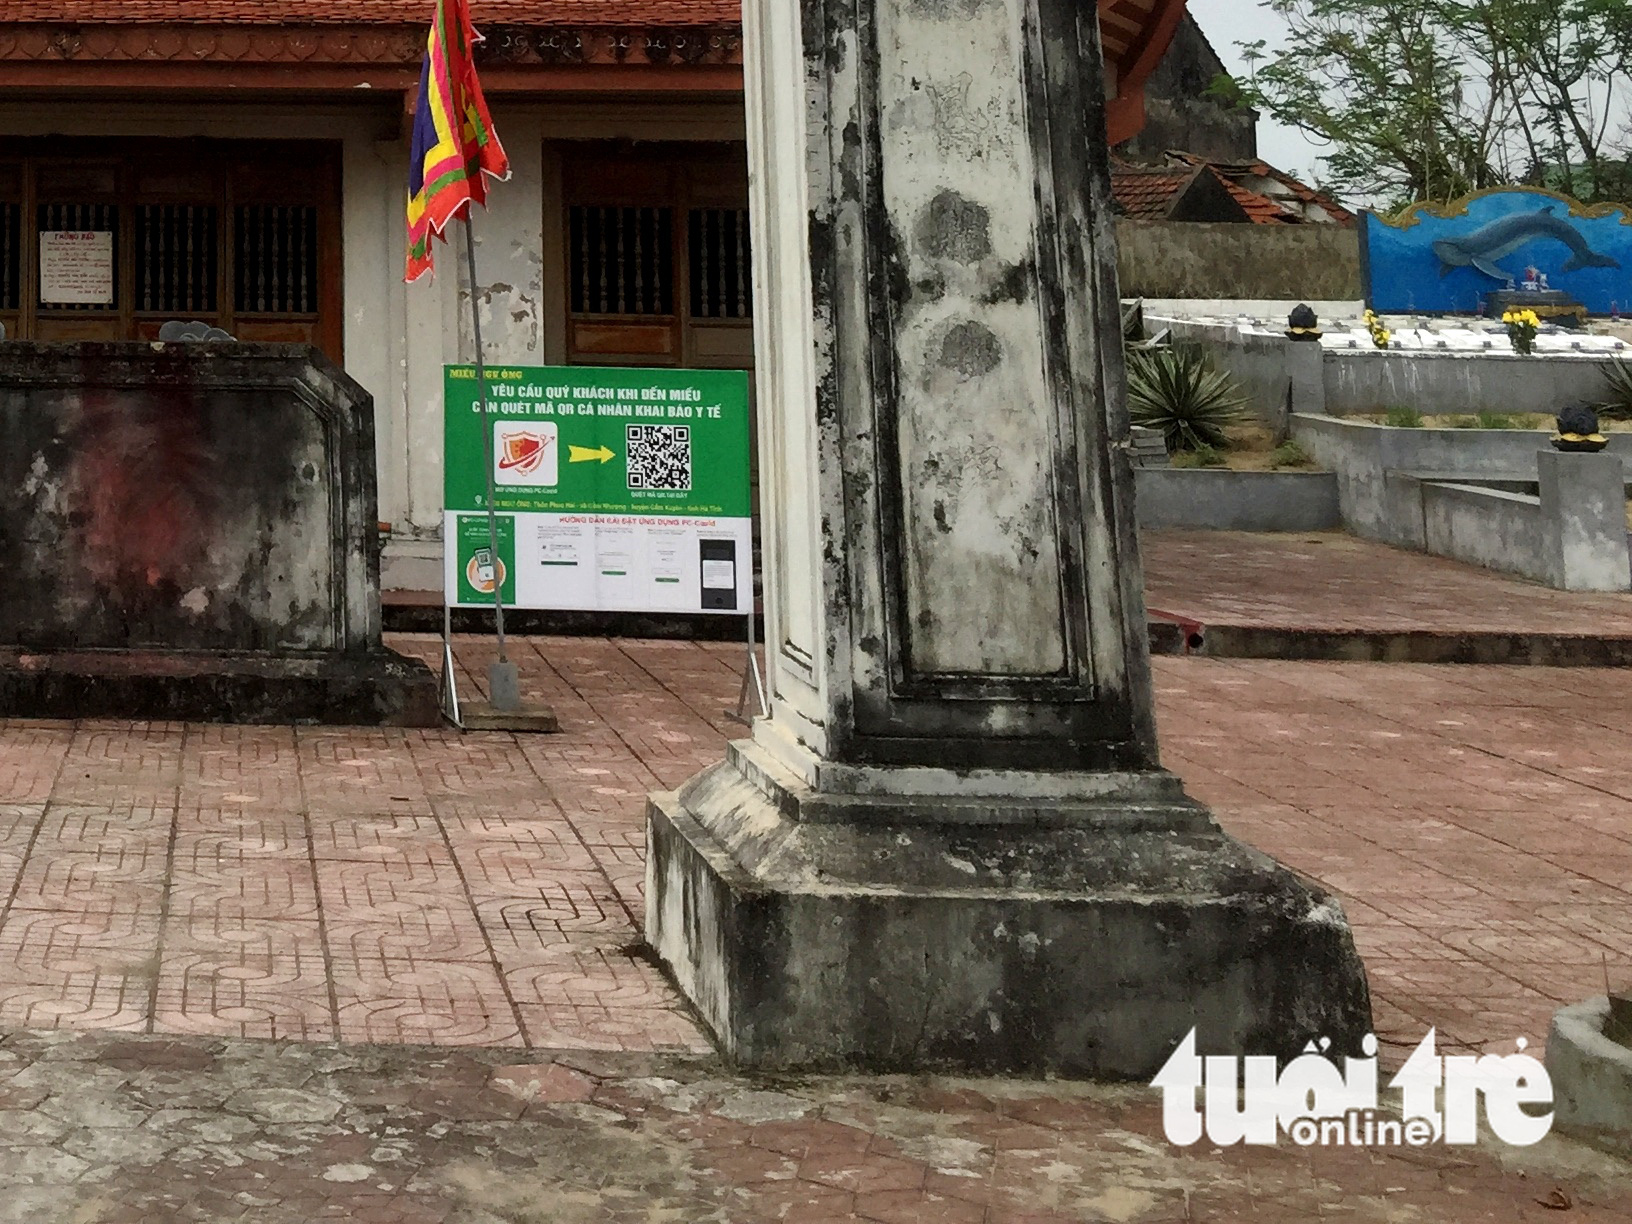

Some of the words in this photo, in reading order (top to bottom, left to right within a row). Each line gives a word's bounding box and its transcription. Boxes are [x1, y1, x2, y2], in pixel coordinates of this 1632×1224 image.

[491, 383, 515, 397] YÊU
[573, 385, 614, 399] KHÁCH
[617, 388, 638, 400] KHI
[641, 385, 667, 401] ĐẾN
[669, 386, 701, 402] MIẾU
[501, 400, 531, 414] QUÉT
[534, 401, 554, 414] MÃ
[557, 403, 574, 416] QR
[577, 401, 594, 415] CÁ
[597, 402, 632, 416] NHÂN
[635, 405, 664, 417] KHAI
[667, 403, 692, 418] BÁO
[695, 406, 703, 418] Y
[706, 403, 722, 418] TẾ
